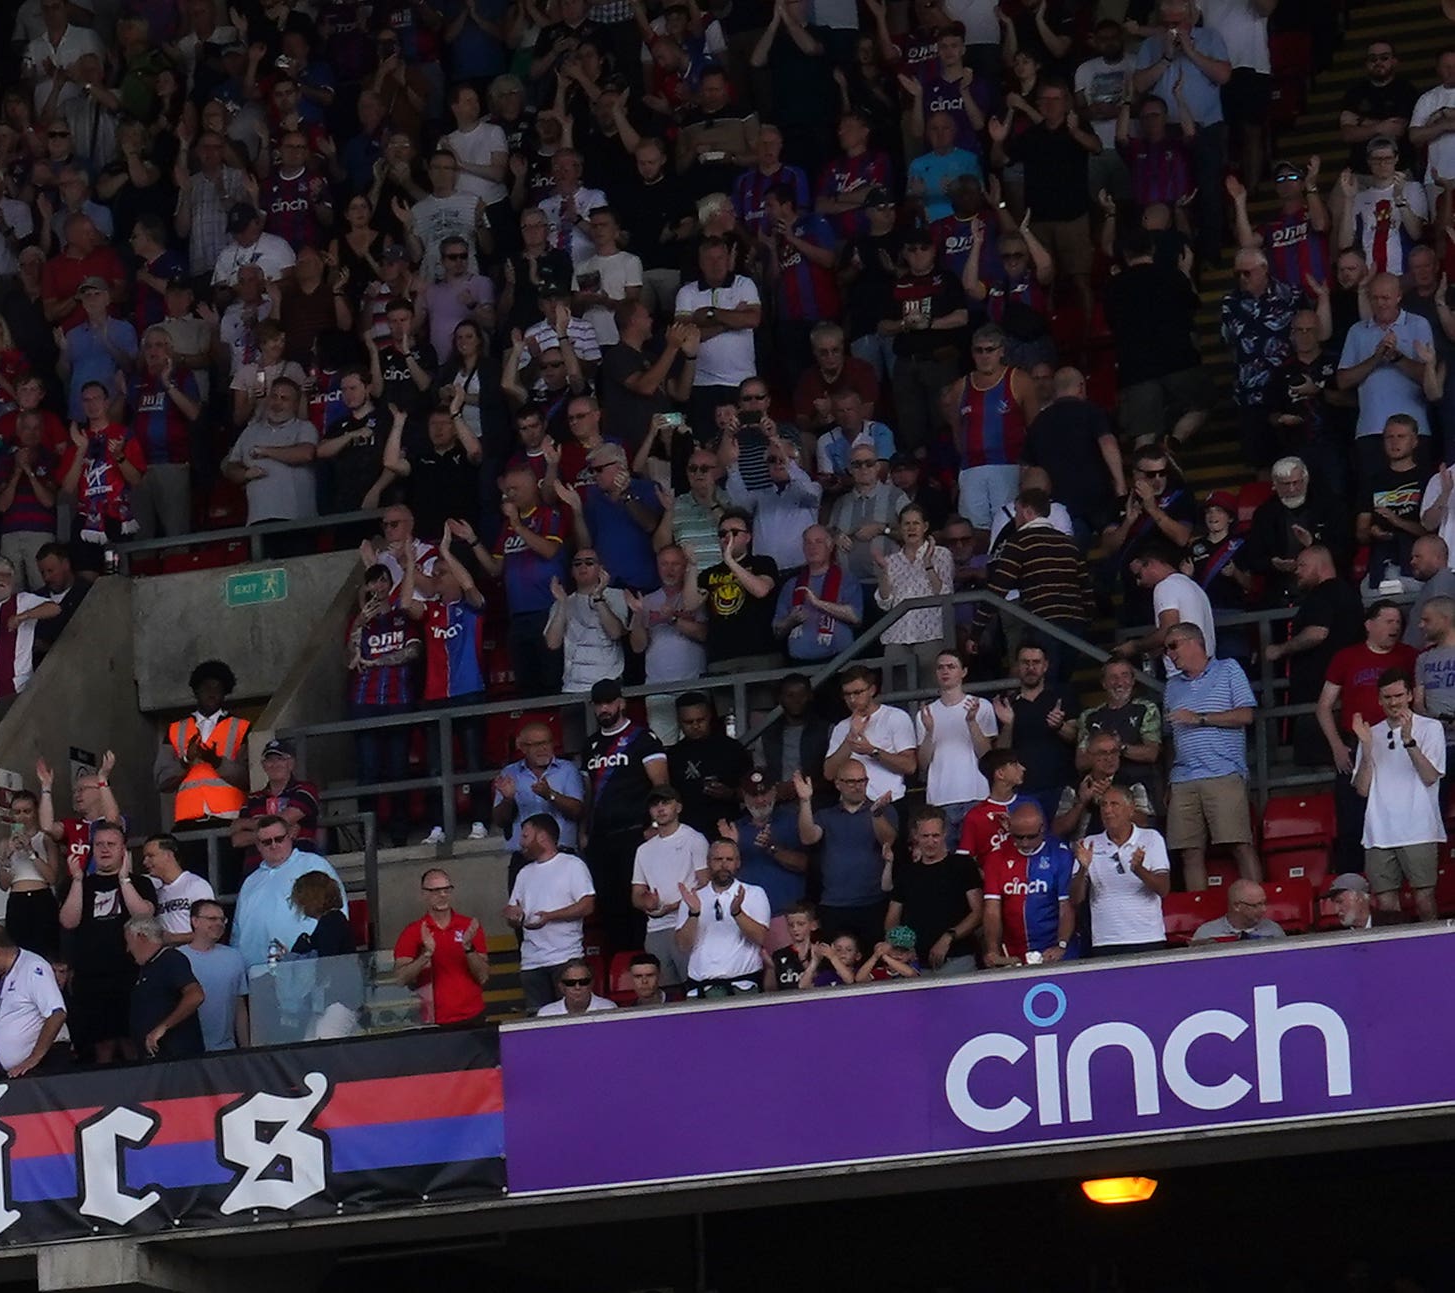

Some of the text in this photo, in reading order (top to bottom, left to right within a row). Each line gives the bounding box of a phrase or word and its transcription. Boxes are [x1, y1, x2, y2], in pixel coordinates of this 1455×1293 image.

[272, 200, 307, 212] cinch
[384, 366, 411, 380] cinc
[235, 584, 257, 595] EXIT
[587, 753, 628, 770] cinch
[1004, 878, 1047, 895] cinch
[781, 968, 801, 983] cin
[945, 983, 1353, 1132] cinch
